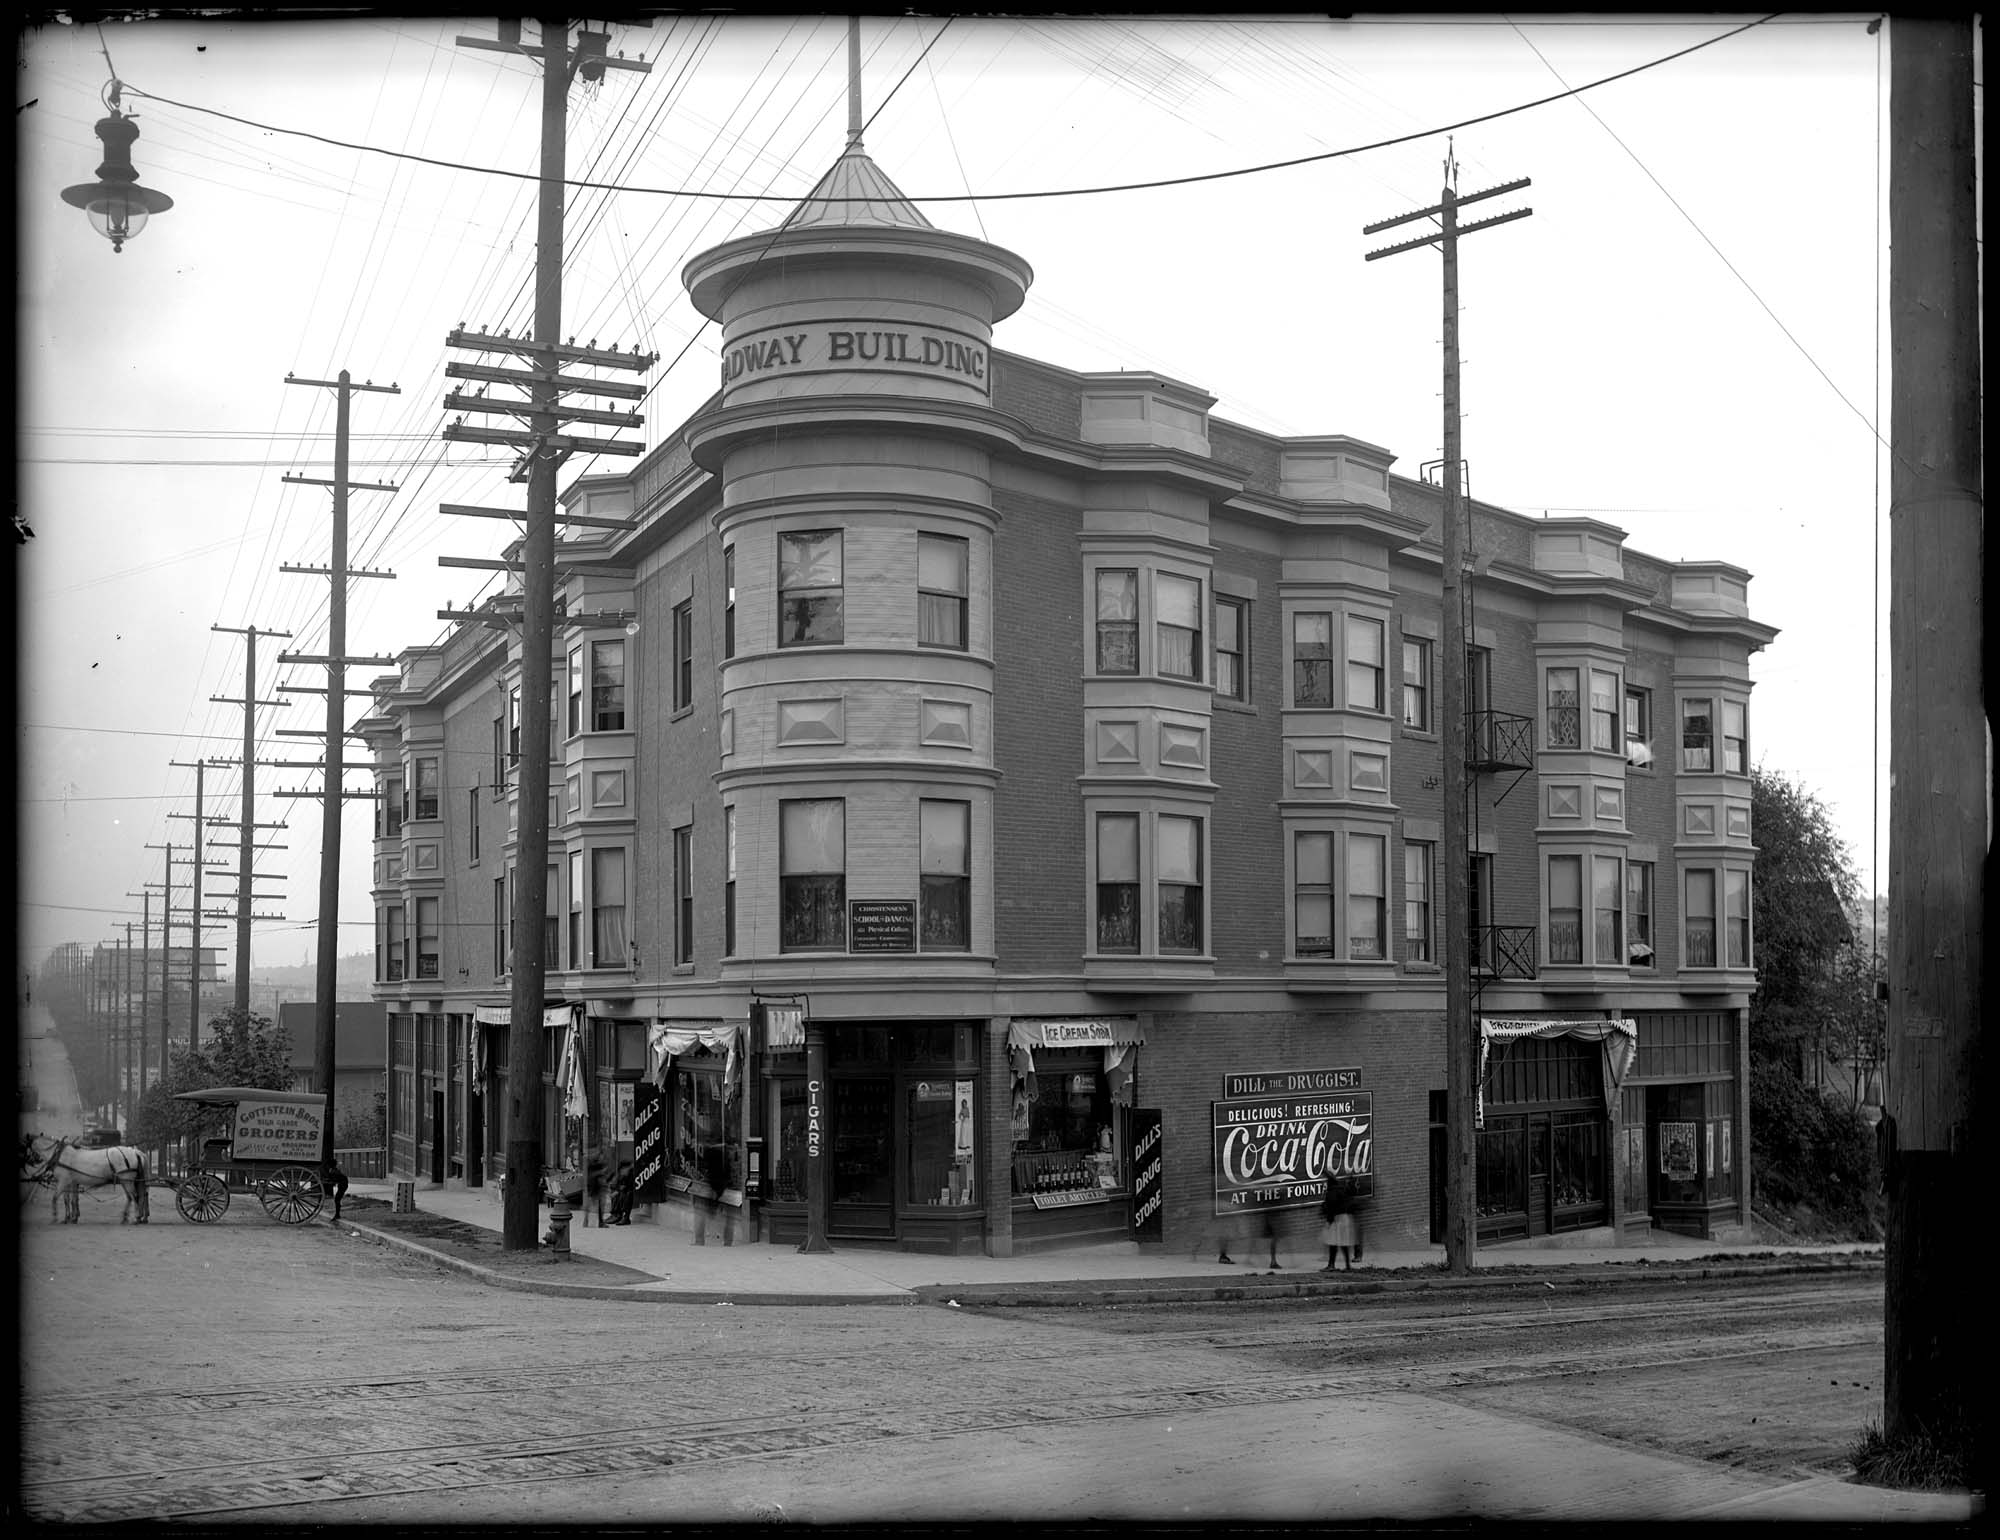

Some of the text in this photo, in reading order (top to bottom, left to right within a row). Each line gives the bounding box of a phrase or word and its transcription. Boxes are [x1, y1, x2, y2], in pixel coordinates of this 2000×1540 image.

[828, 331, 984, 378] BUILDING
[1044, 1024, 1111, 1041] ICE CREAM SODA
[1233, 1077, 1266, 1093] DILL
[1269, 1079, 1284, 1088] THE
[240, 1105, 296, 1123] GOTTSTEIN
[634, 1099, 660, 1132] DILL'S
[808, 1080, 820, 1157] CIGARS
[1228, 1099, 1355, 1122] DELICIOUS! REFRESHING!
[239, 1128, 319, 1140] GROCERS
[635, 1127, 661, 1161] DRUG
[1135, 1124, 1161, 1162] DILL'S
[1256, 1121, 1307, 1138] DRINK
[1222, 1117, 1371, 1186] Coca-Cola
[634, 1154, 661, 1190] STORE
[1136, 1157, 1161, 1195] DRUG
[1135, 1188, 1162, 1227] STORE
[1230, 1192, 1248, 1205] AT
[1254, 1187, 1281, 1202] THE
